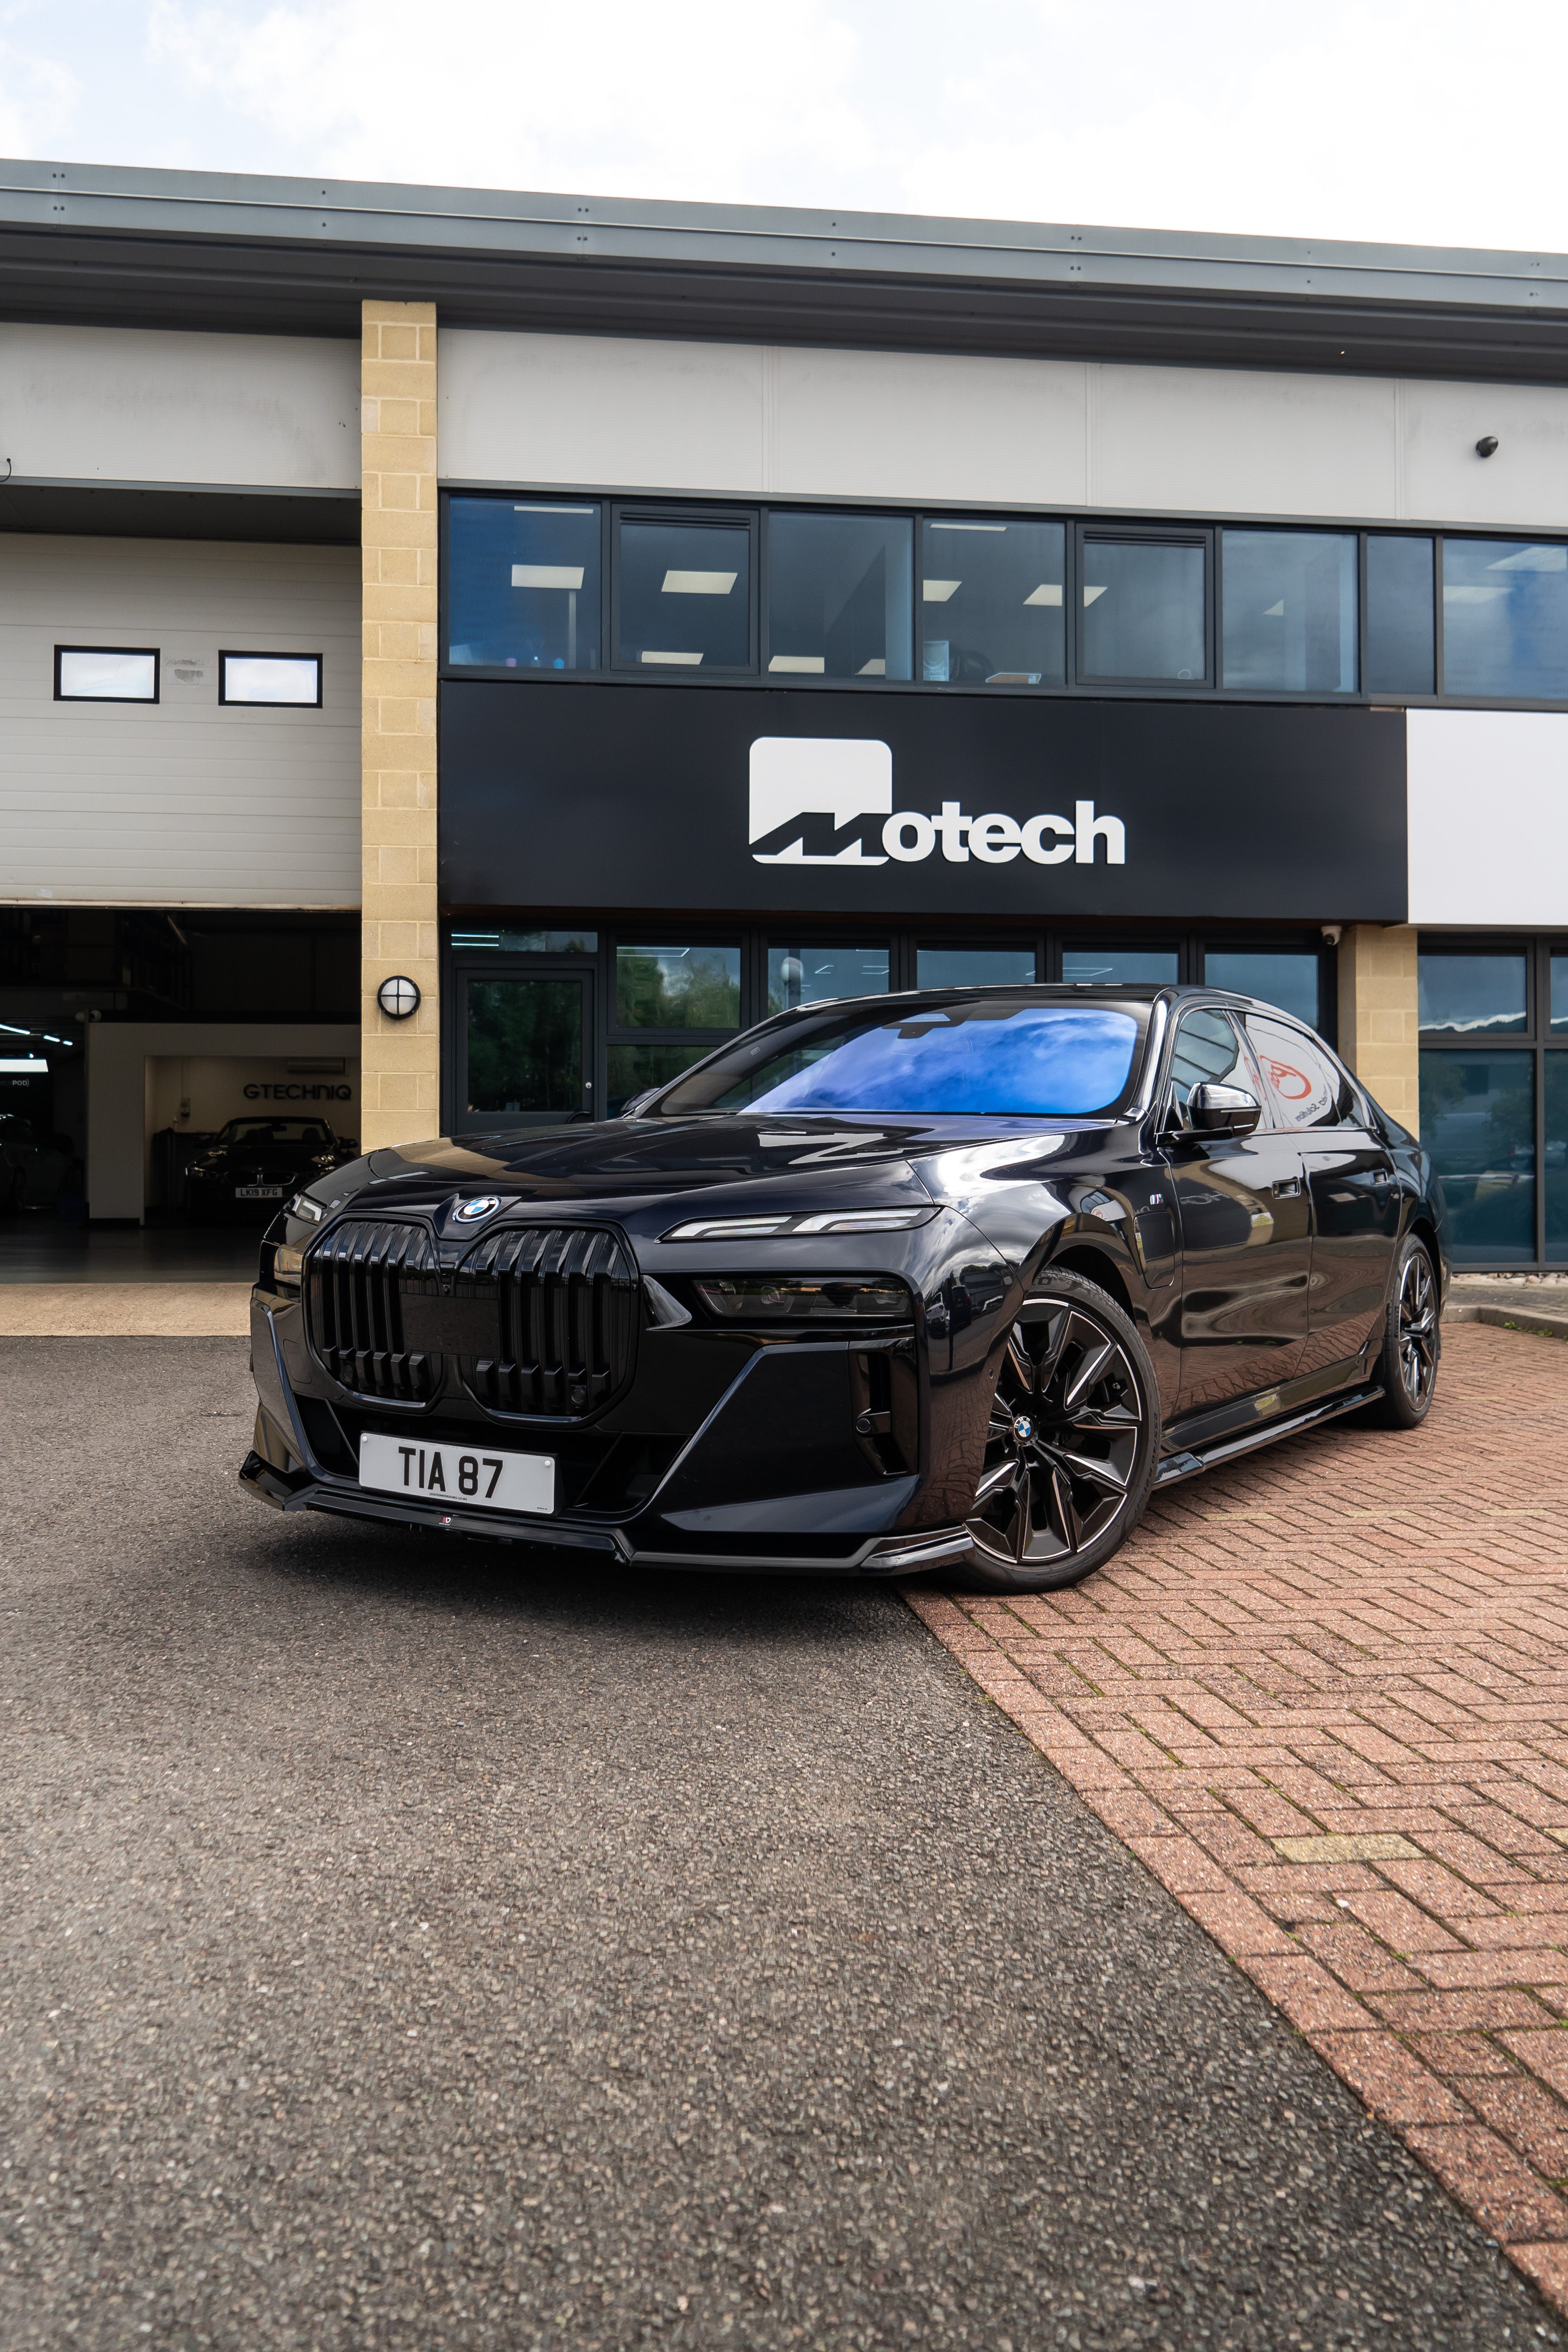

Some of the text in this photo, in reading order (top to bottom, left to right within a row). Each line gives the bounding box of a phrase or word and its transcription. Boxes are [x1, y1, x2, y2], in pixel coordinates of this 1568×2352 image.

[243, 1084, 352, 1100] GTECHNIQ
[398, 1446, 503, 1499] TIA 87
